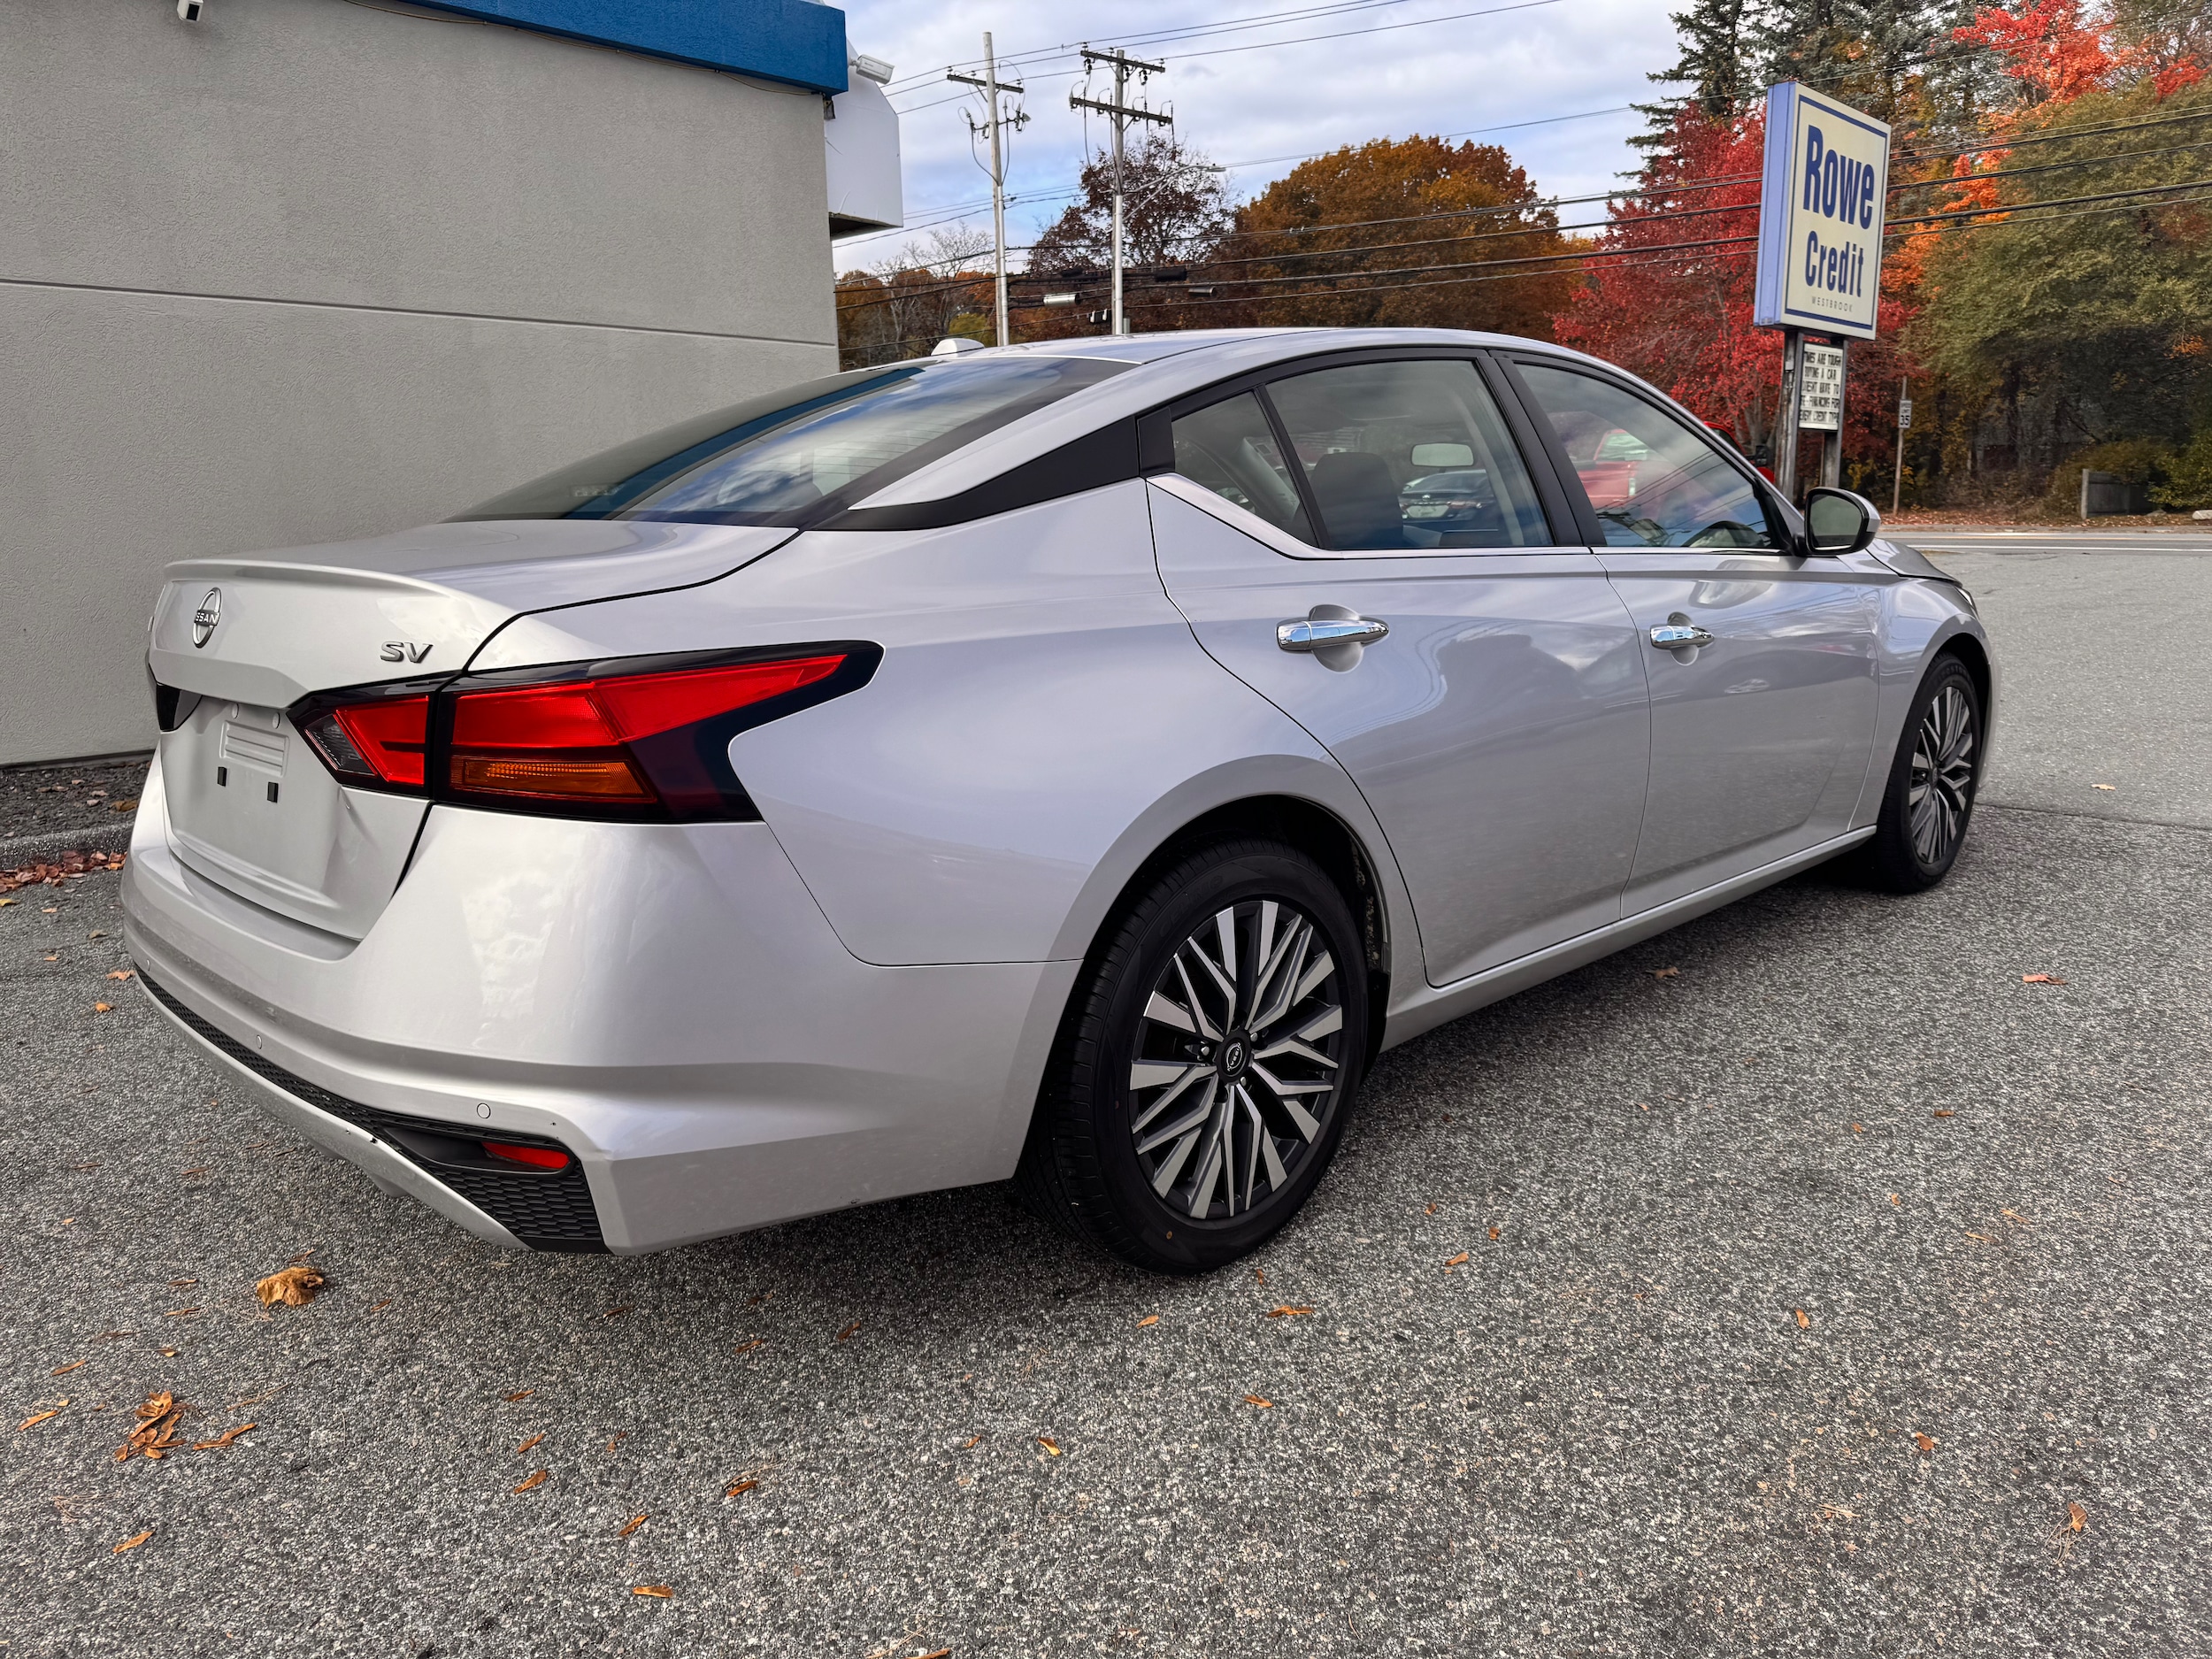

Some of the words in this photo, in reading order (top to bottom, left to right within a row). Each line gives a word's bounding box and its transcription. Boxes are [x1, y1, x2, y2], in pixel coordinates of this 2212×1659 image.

[1803, 124, 1874, 229] Rowe
[1805, 230, 1864, 297] Credit
[1811, 296, 1853, 312] WESTBROOK
[1827, 368, 1837, 380] CAR
[1900, 415, 1910, 426] 35
[380, 641, 434, 664] SV
